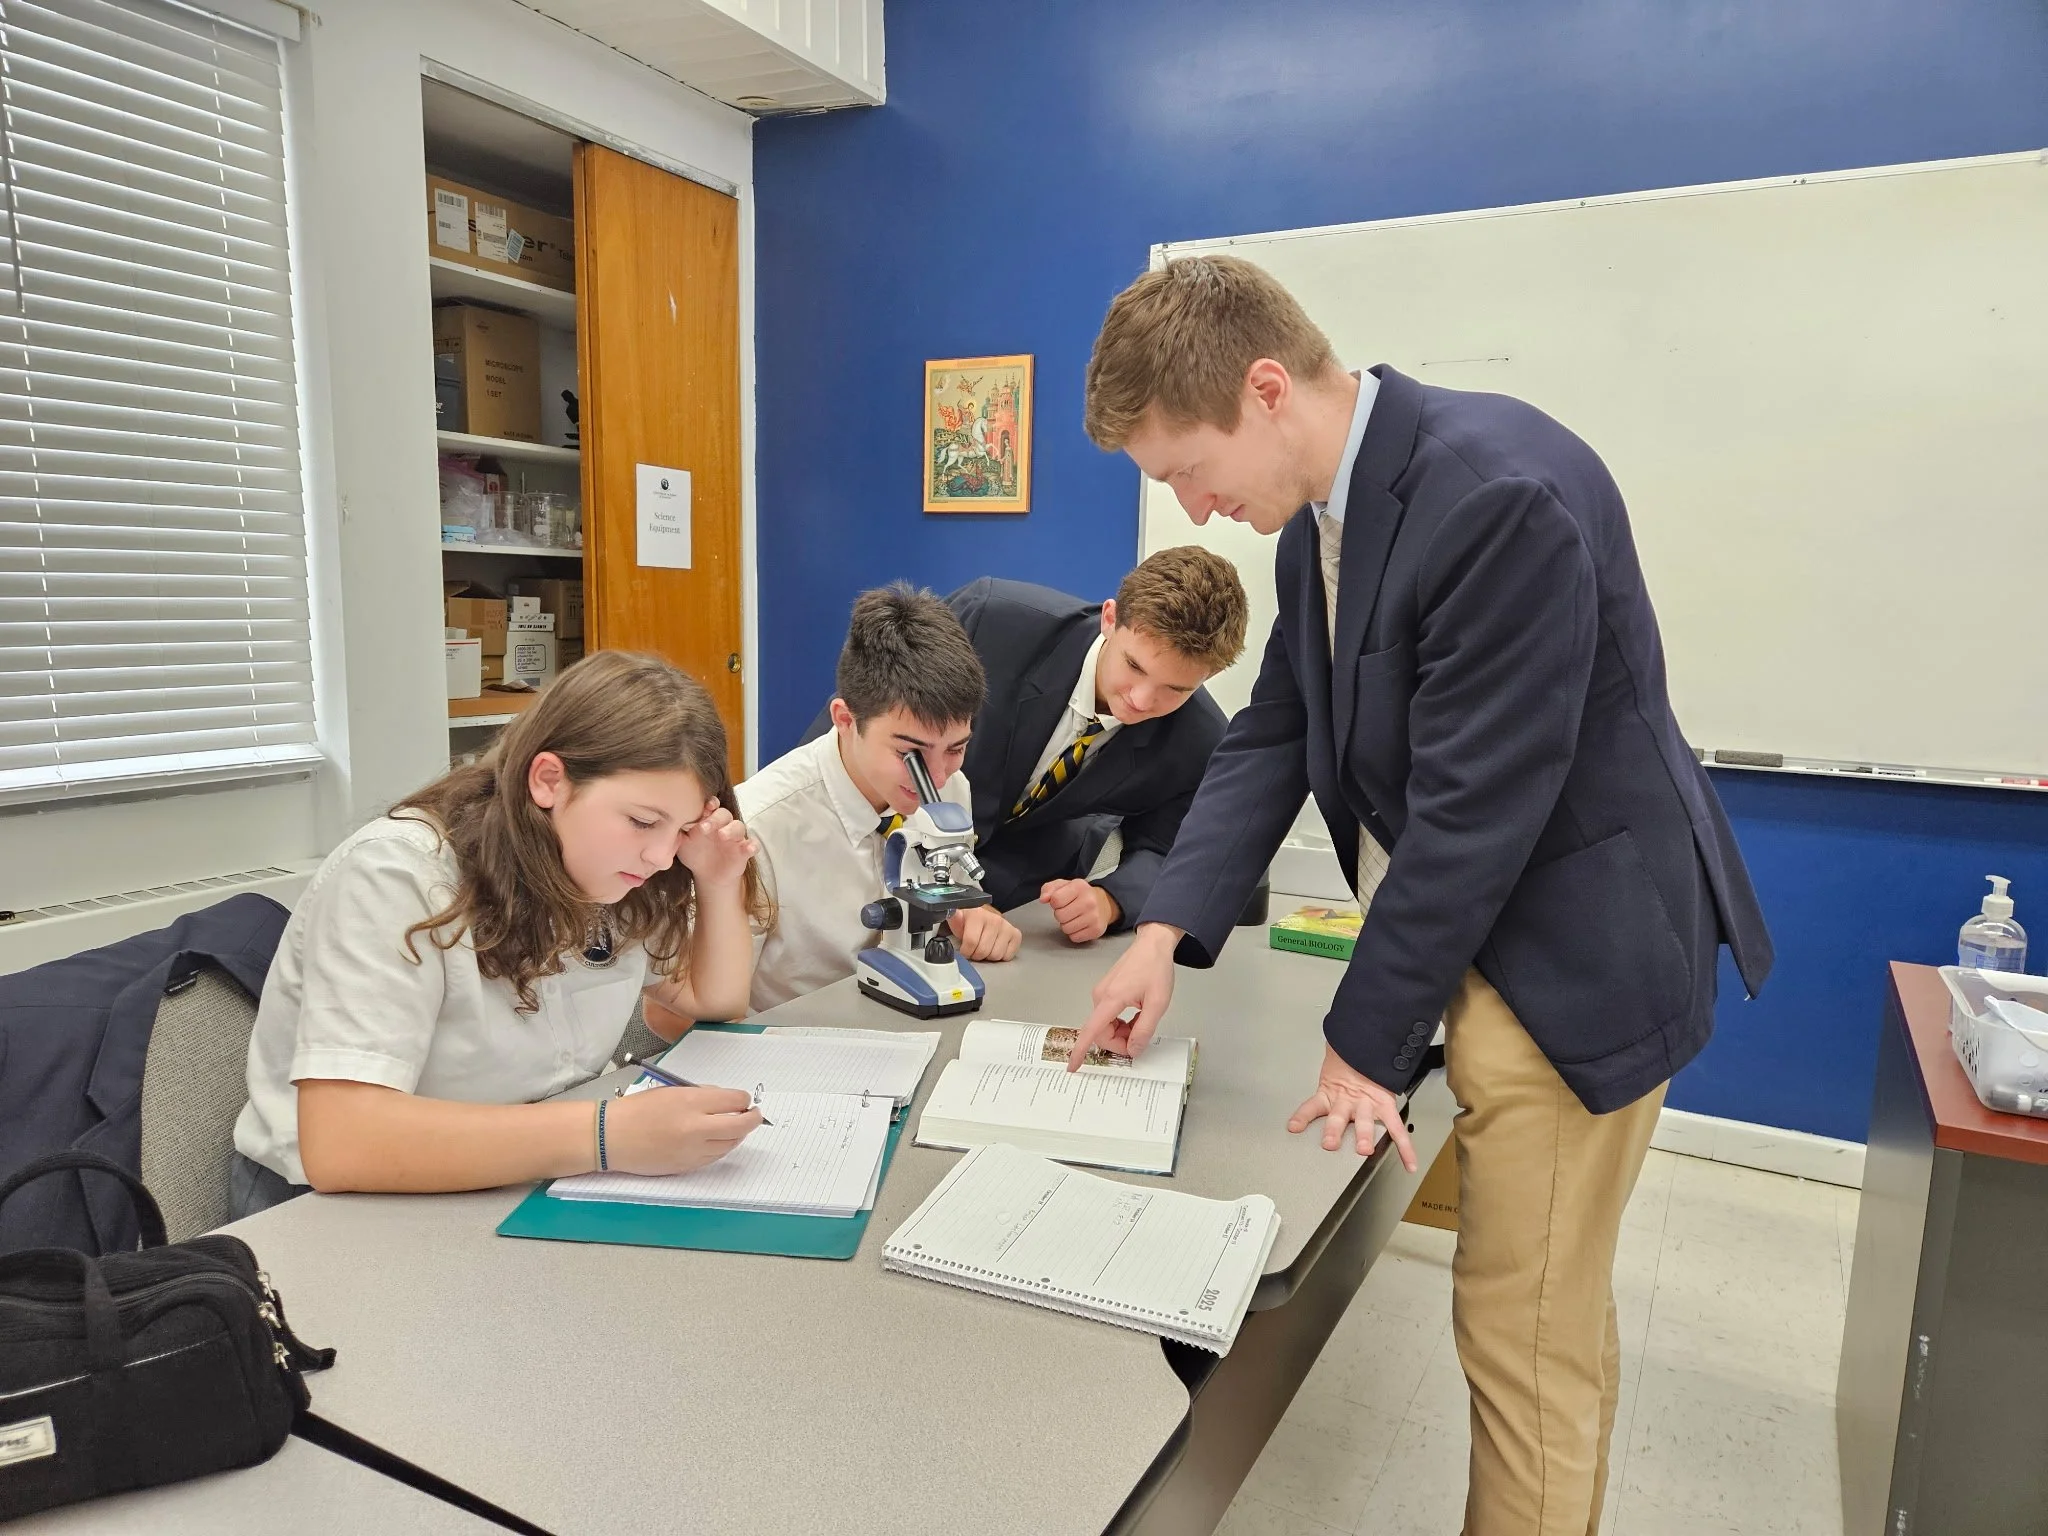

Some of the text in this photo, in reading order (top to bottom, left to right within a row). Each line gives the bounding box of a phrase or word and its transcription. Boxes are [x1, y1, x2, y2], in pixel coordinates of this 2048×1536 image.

[485, 359, 523, 372] MICROSCOPE
[485, 374, 507, 385] MODEL
[490, 390, 502, 398] SET
[654, 511, 676, 522] Science
[649, 523, 681, 534] Equipment
[1277, 935, 1345, 952] General BIOLOGY
[1421, 1201, 1443, 1211] MADE
[1444, 1205, 1452, 1213] IN
[1198, 1288, 1220, 1312] 2025
